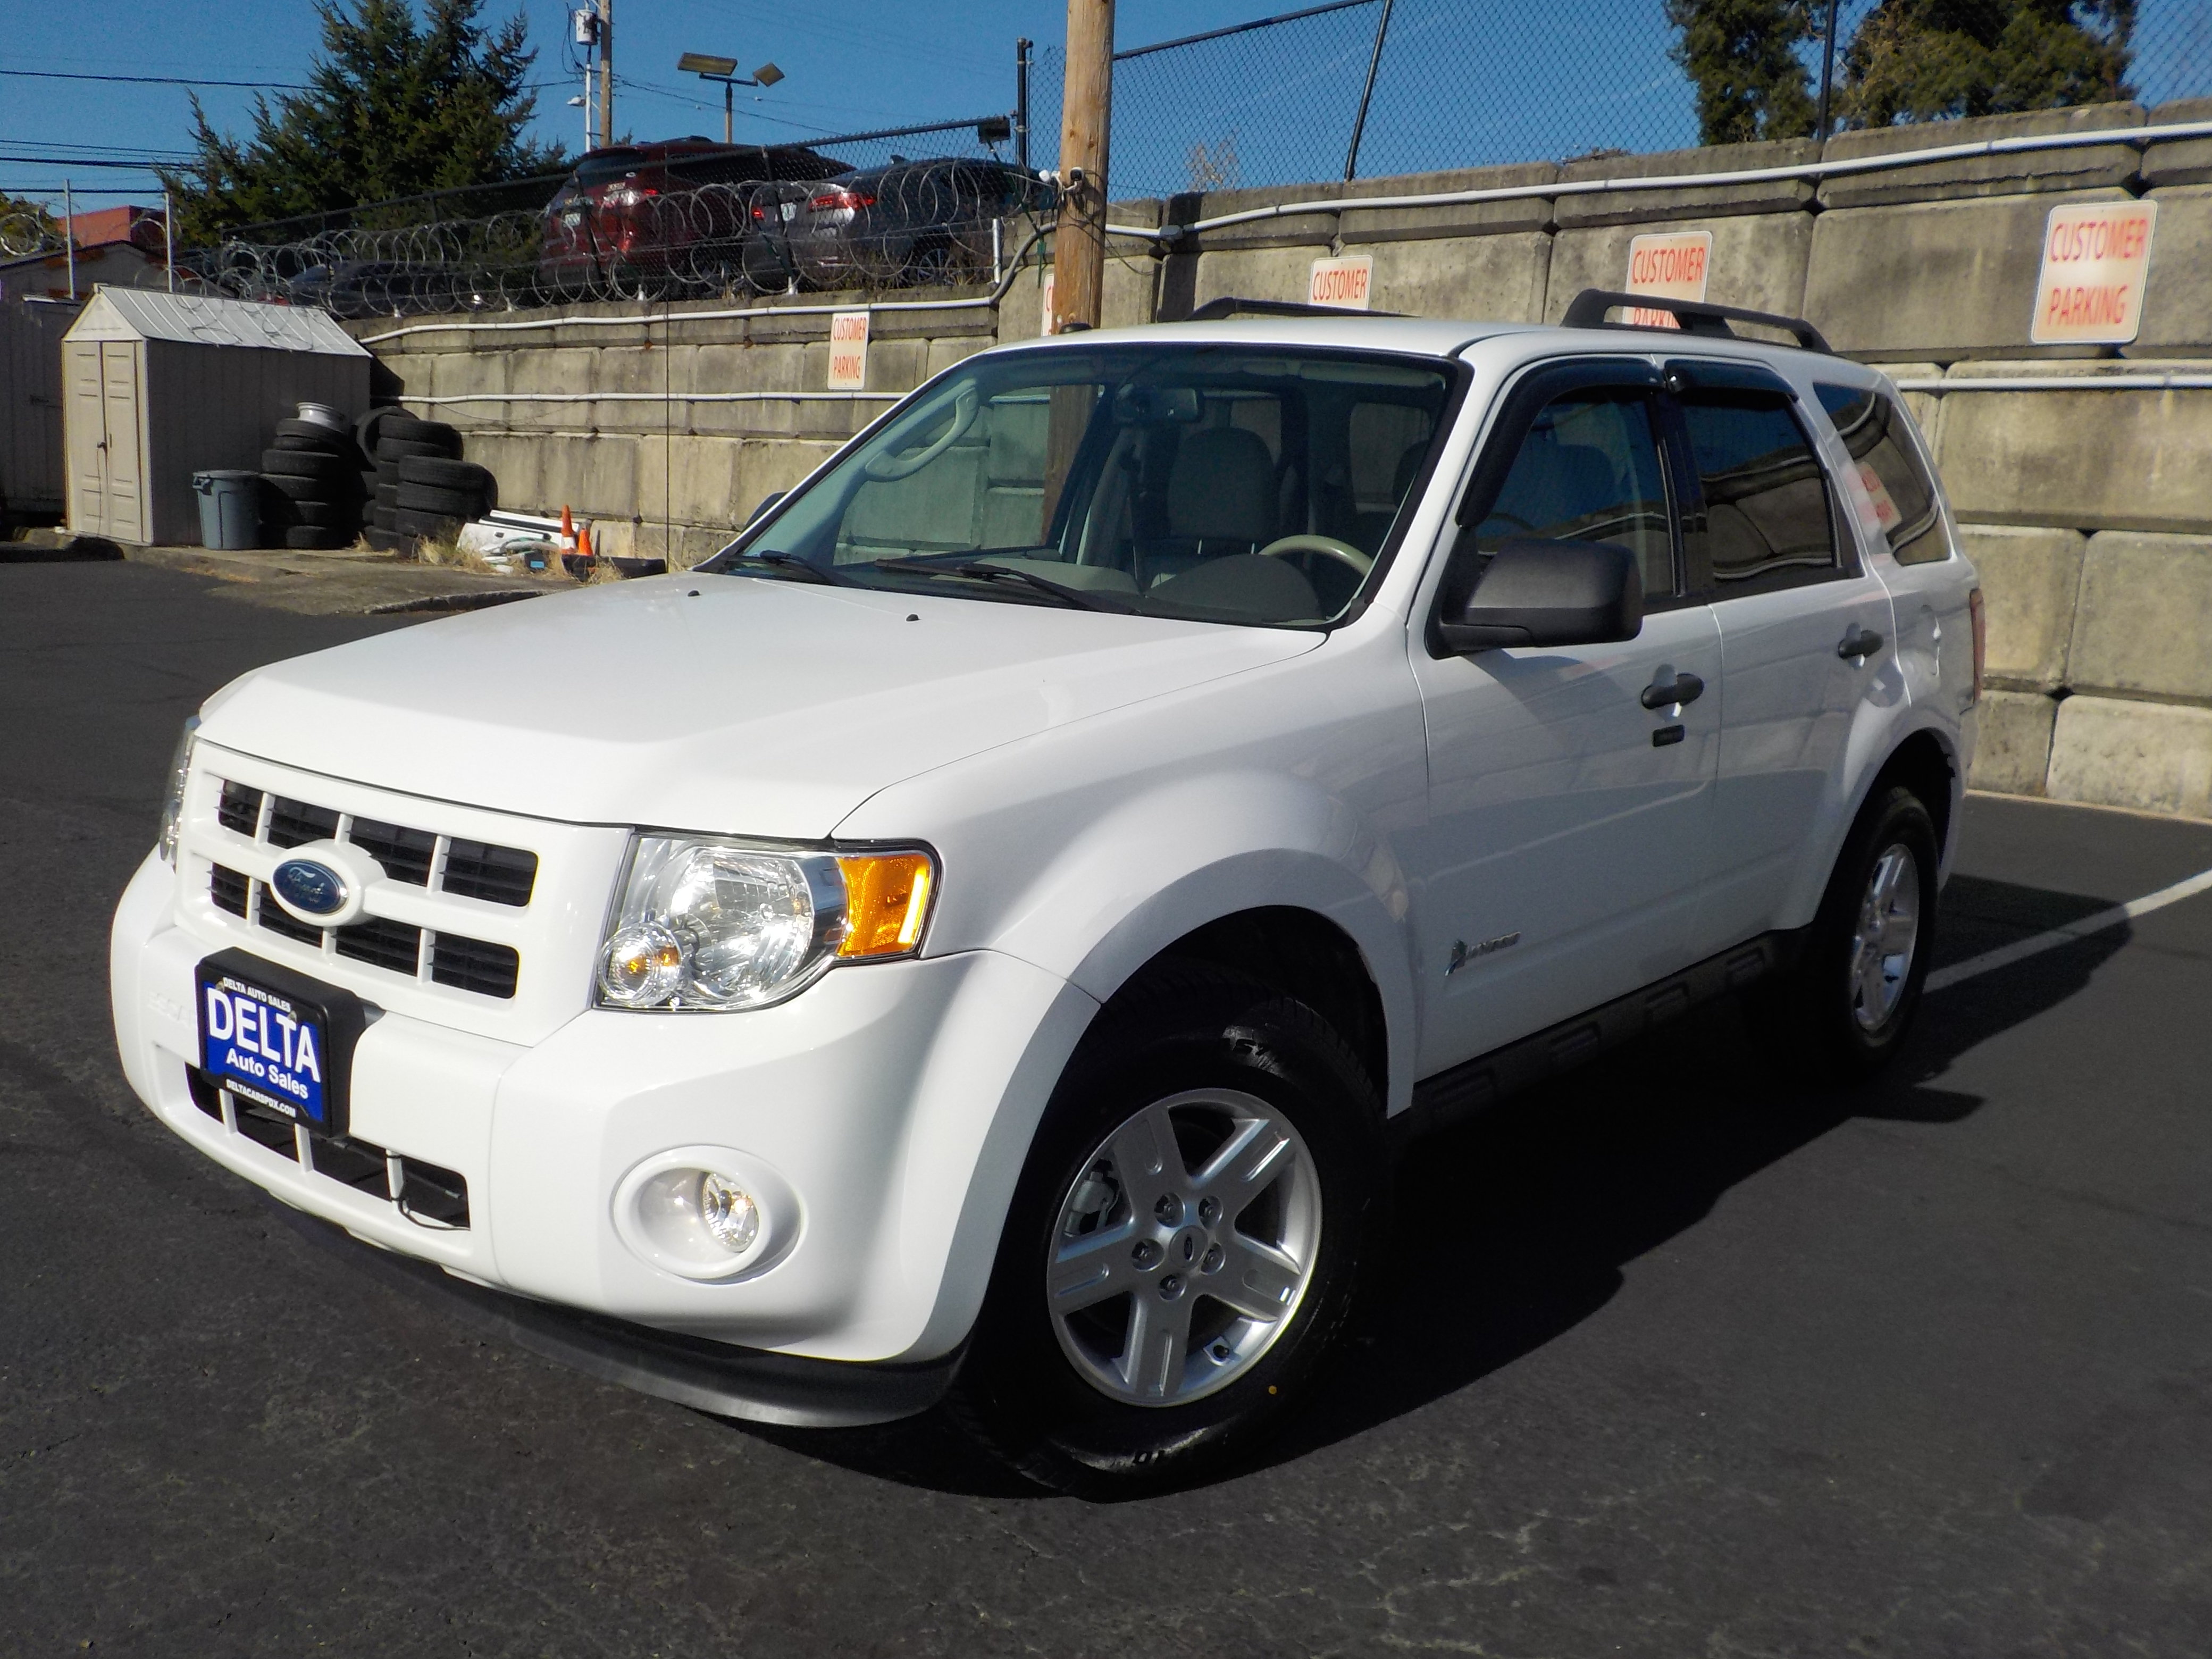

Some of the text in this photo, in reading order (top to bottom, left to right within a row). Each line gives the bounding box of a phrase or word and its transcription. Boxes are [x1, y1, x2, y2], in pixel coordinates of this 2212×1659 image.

[2051, 219, 2148, 262] CUSTOMER
[1632, 247, 1705, 284] CUSTOMER
[1312, 268, 1368, 301] CUSTOMER
[2047, 285, 2128, 325] PARKING
[833, 317, 867, 341] CUSTOMER
[833, 355, 861, 379] PARKING
[222, 977, 291, 1013] DELTA AUTO SALES
[207, 987, 321, 1083] DELTA
[226, 1048, 309, 1100] Auto Sales
